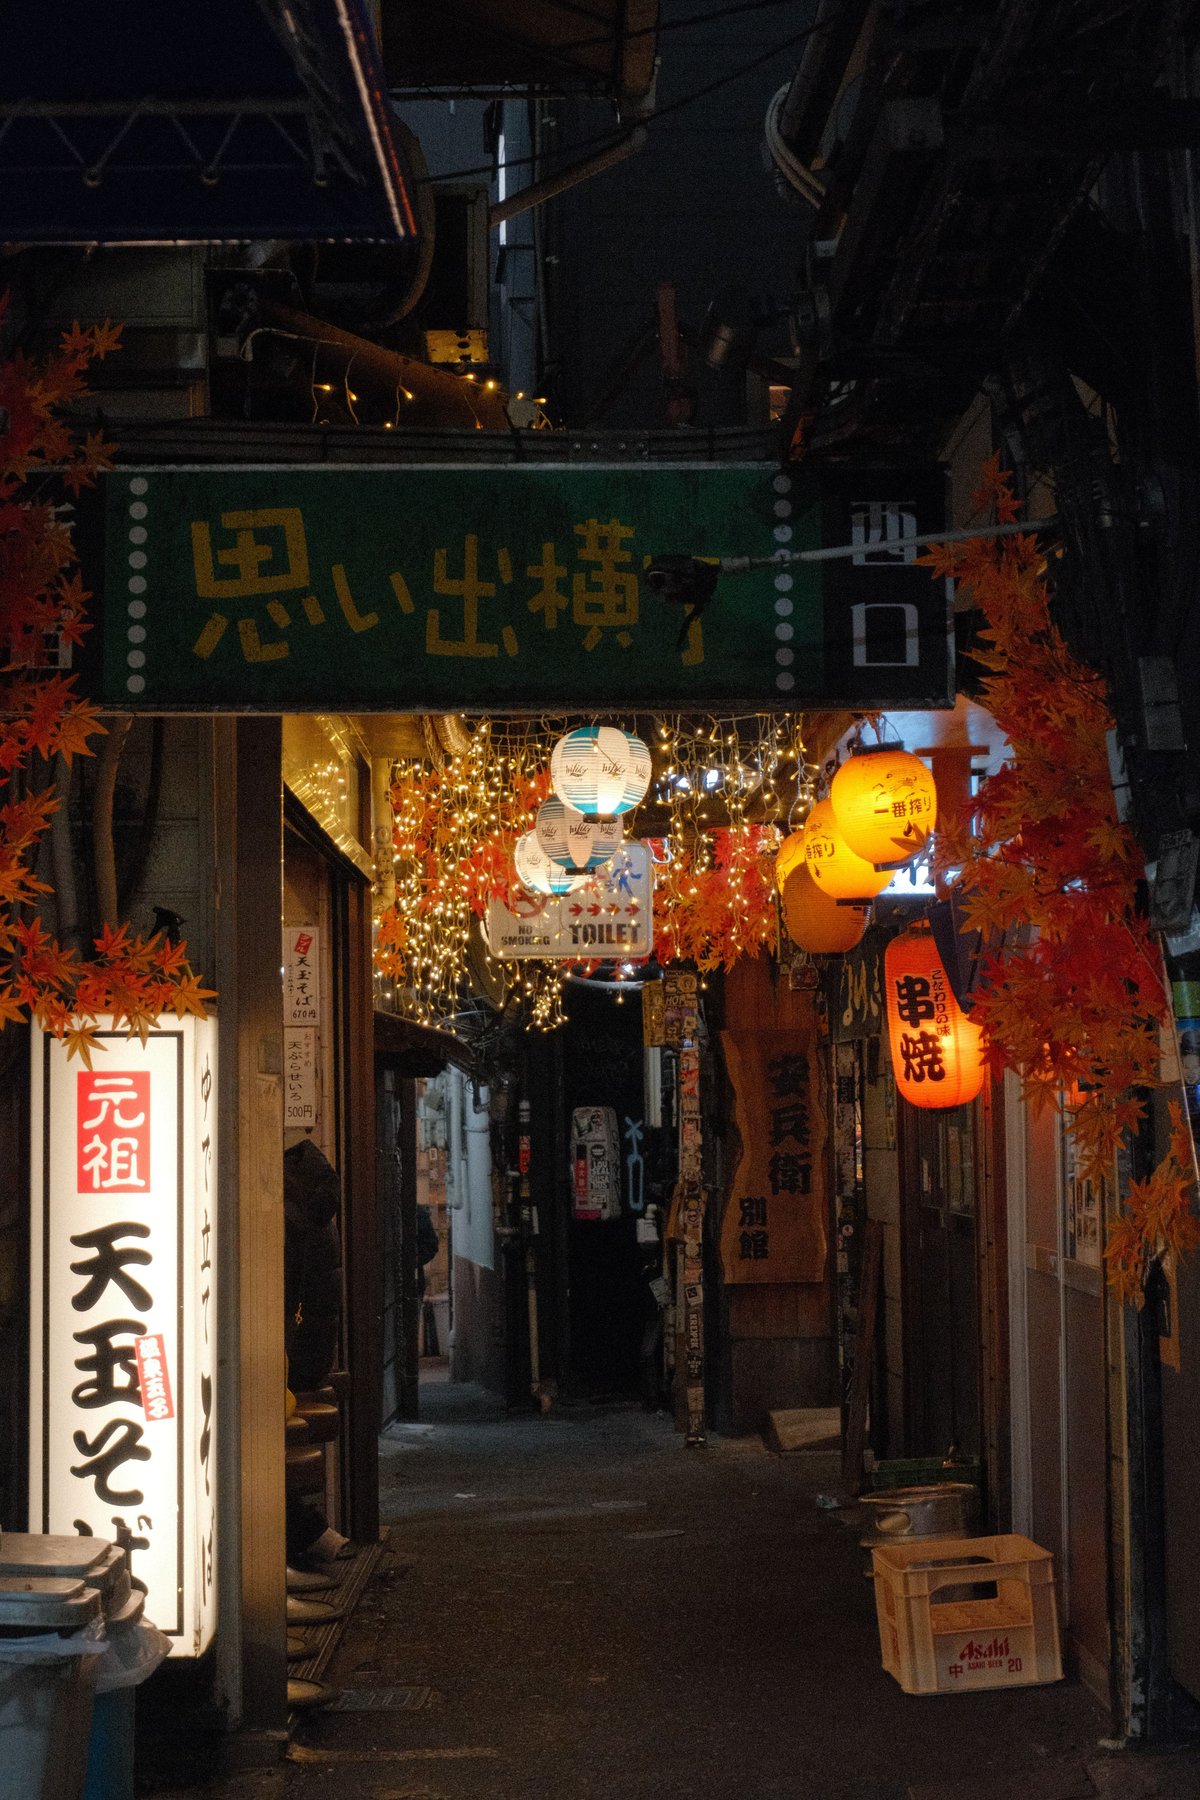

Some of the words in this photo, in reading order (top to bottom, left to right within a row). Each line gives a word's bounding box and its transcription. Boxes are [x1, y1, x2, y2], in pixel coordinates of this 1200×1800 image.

[851, 500, 919, 667] 西口
[874, 796, 931, 817] 一番搾り
[501, 935, 550, 946] SMOKING
[518, 926, 533, 935] NO
[569, 923, 641, 944] TOILET
[295, 956, 313, 1006] 天玉そば
[931, 969, 951, 1036] こだわりの味
[895, 975, 945, 1083] 串焼
[287, 1041, 303, 1101] 天ぷらせいろ
[287, 1105, 312, 1119] 500円
[83, 1077, 146, 1190] 元祖
[739, 1197, 768, 1260] 別館
[960, 1636, 1010, 1660] Asahi
[949, 1664, 963, 1678] 中
[1008, 1658, 1022, 1673] 20
